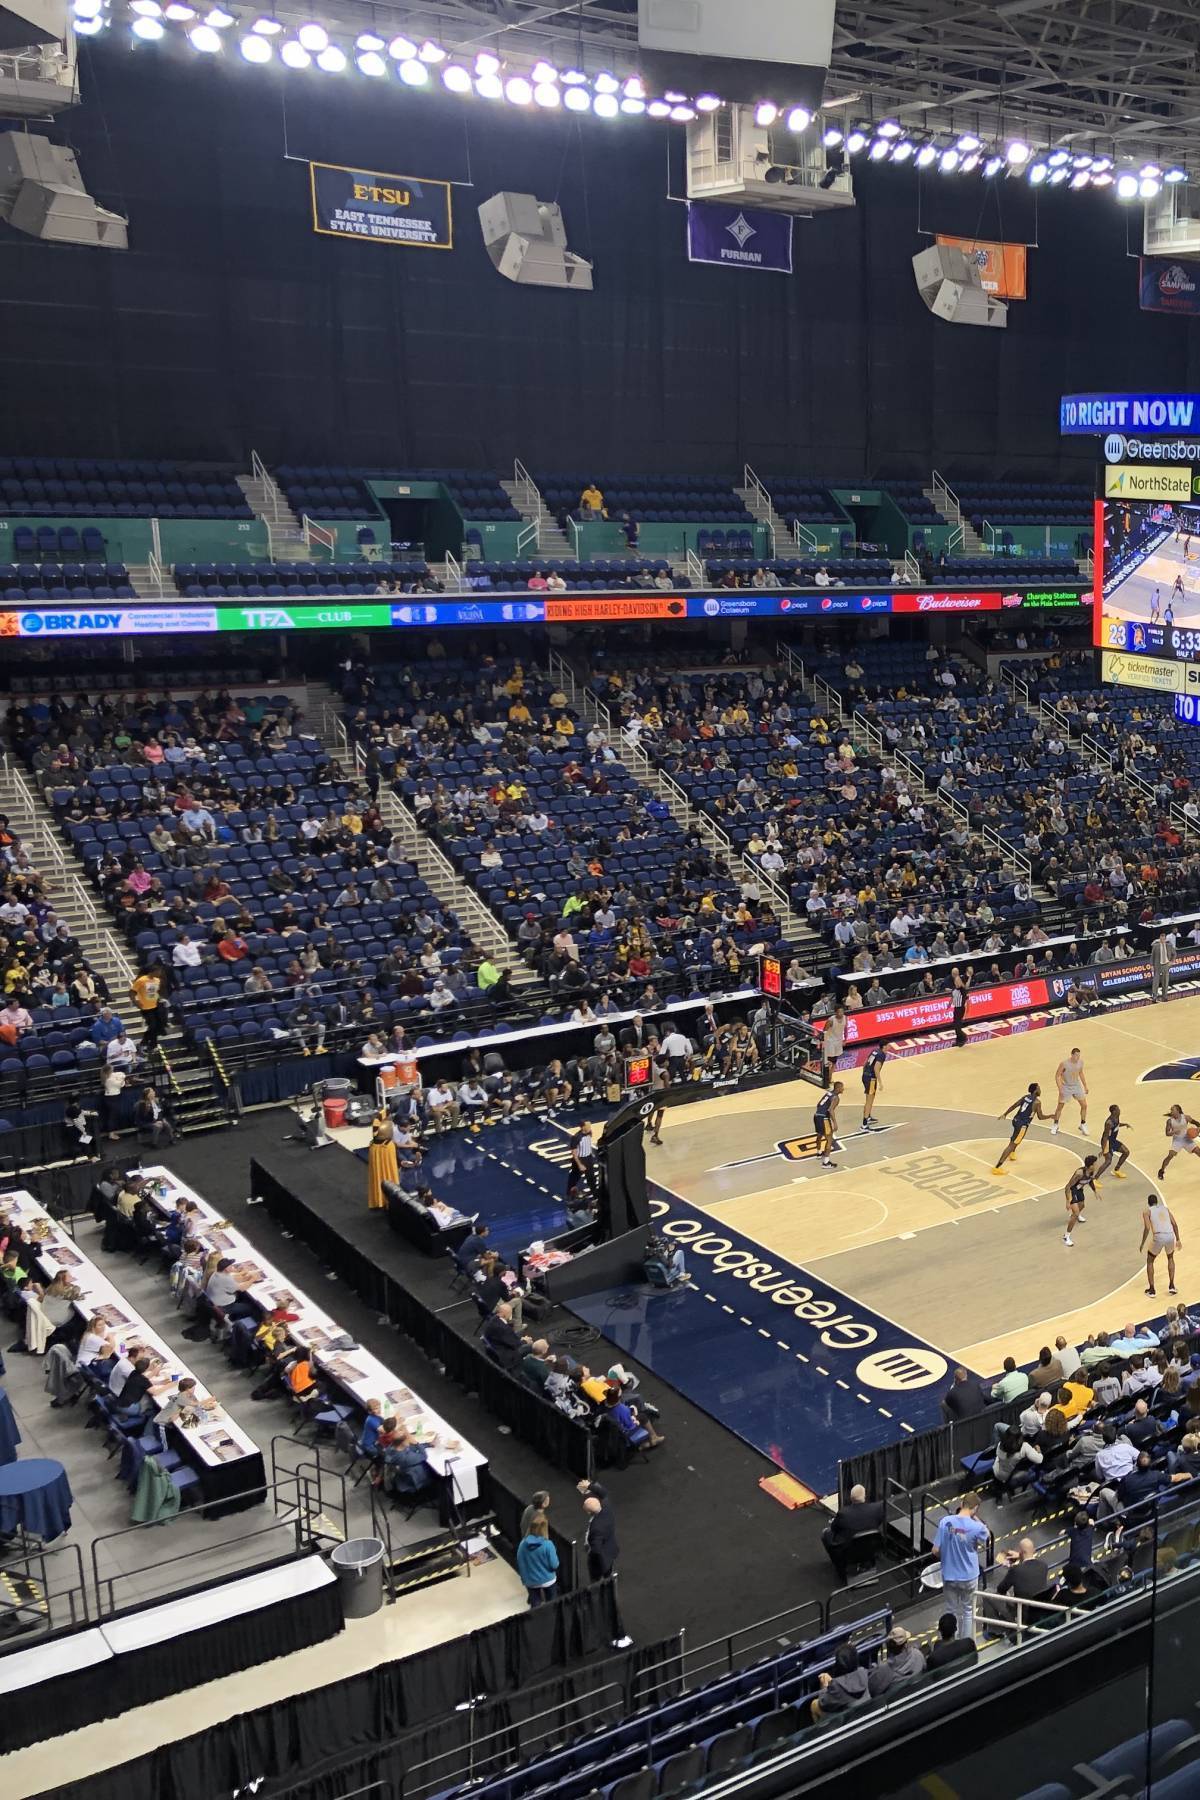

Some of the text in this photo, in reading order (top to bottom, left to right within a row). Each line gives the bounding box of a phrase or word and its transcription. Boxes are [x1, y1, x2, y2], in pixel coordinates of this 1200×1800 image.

[354, 184, 410, 206] ETSU
[335, 209, 432, 231] EAST TENNESSEE
[330, 220, 437, 242] STATE UNIVERSITY
[721, 248, 762, 263] FURMAN
[1161, 279, 1196, 291] SAMFORD
[1065, 402, 1077, 426] TO
[1078, 401, 1129, 426] RIGHT
[1133, 401, 1194, 427] NOW
[1129, 476, 1190, 493] NorthState
[720, 600, 757, 608] Greensboro
[872, 600, 887, 608] pepsi
[916, 595, 982, 610] Budweiser
[1026, 593, 1052, 601] Charging
[1053, 592, 1077, 600] Stations
[575, 603, 592, 615] HIGH
[832, 601, 848, 609] pepsi
[45, 613, 123, 630] BRADY
[241, 609, 296, 628] TFA
[316, 612, 352, 622] CLUB
[1108, 624, 1127, 646] 23
[1176, 650, 1189, 658] HALF
[1127, 661, 1175, 678] ticketmaster
[1151, 676, 1172, 686] TICKETS
[1178, 695, 1195, 720] TO
[1101, 970, 1121, 979] BRYAN
[1122, 965, 1145, 975] SCHOOL
[1183, 954, 1195, 963] AND
[1102, 974, 1143, 987] CELEBRATING
[876, 1010, 894, 1023] 3352
[895, 1007, 918, 1020] WEST
[878, 1154, 1019, 1210] SOCON
[662, 1219, 878, 1349] Greensboro
